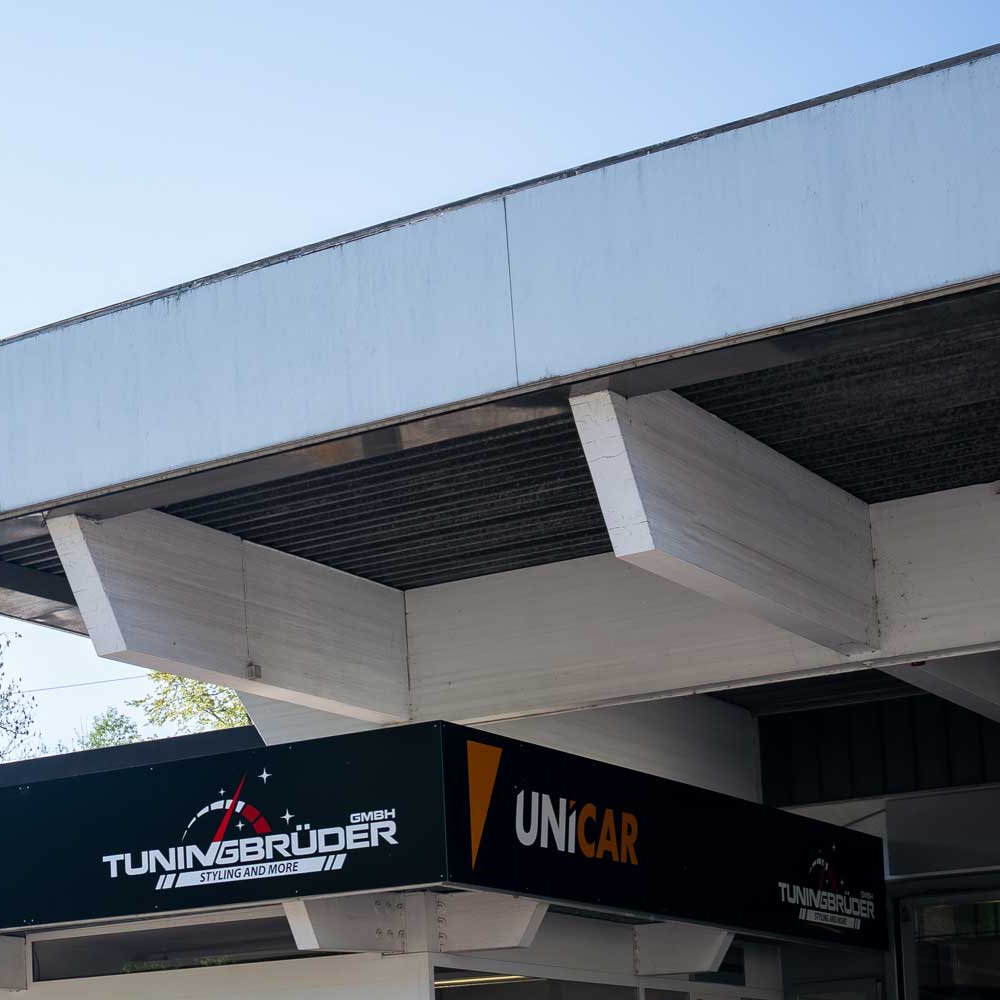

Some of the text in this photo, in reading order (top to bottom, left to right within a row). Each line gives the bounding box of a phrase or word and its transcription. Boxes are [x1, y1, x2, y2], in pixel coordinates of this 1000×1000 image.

[349, 808, 396, 824] GMBH
[102, 820, 399, 878] TUNINGBRÜDER
[199, 861, 299, 882] STYLING AND MORE
[778, 881, 876, 920] TUNINGBRÜDER
